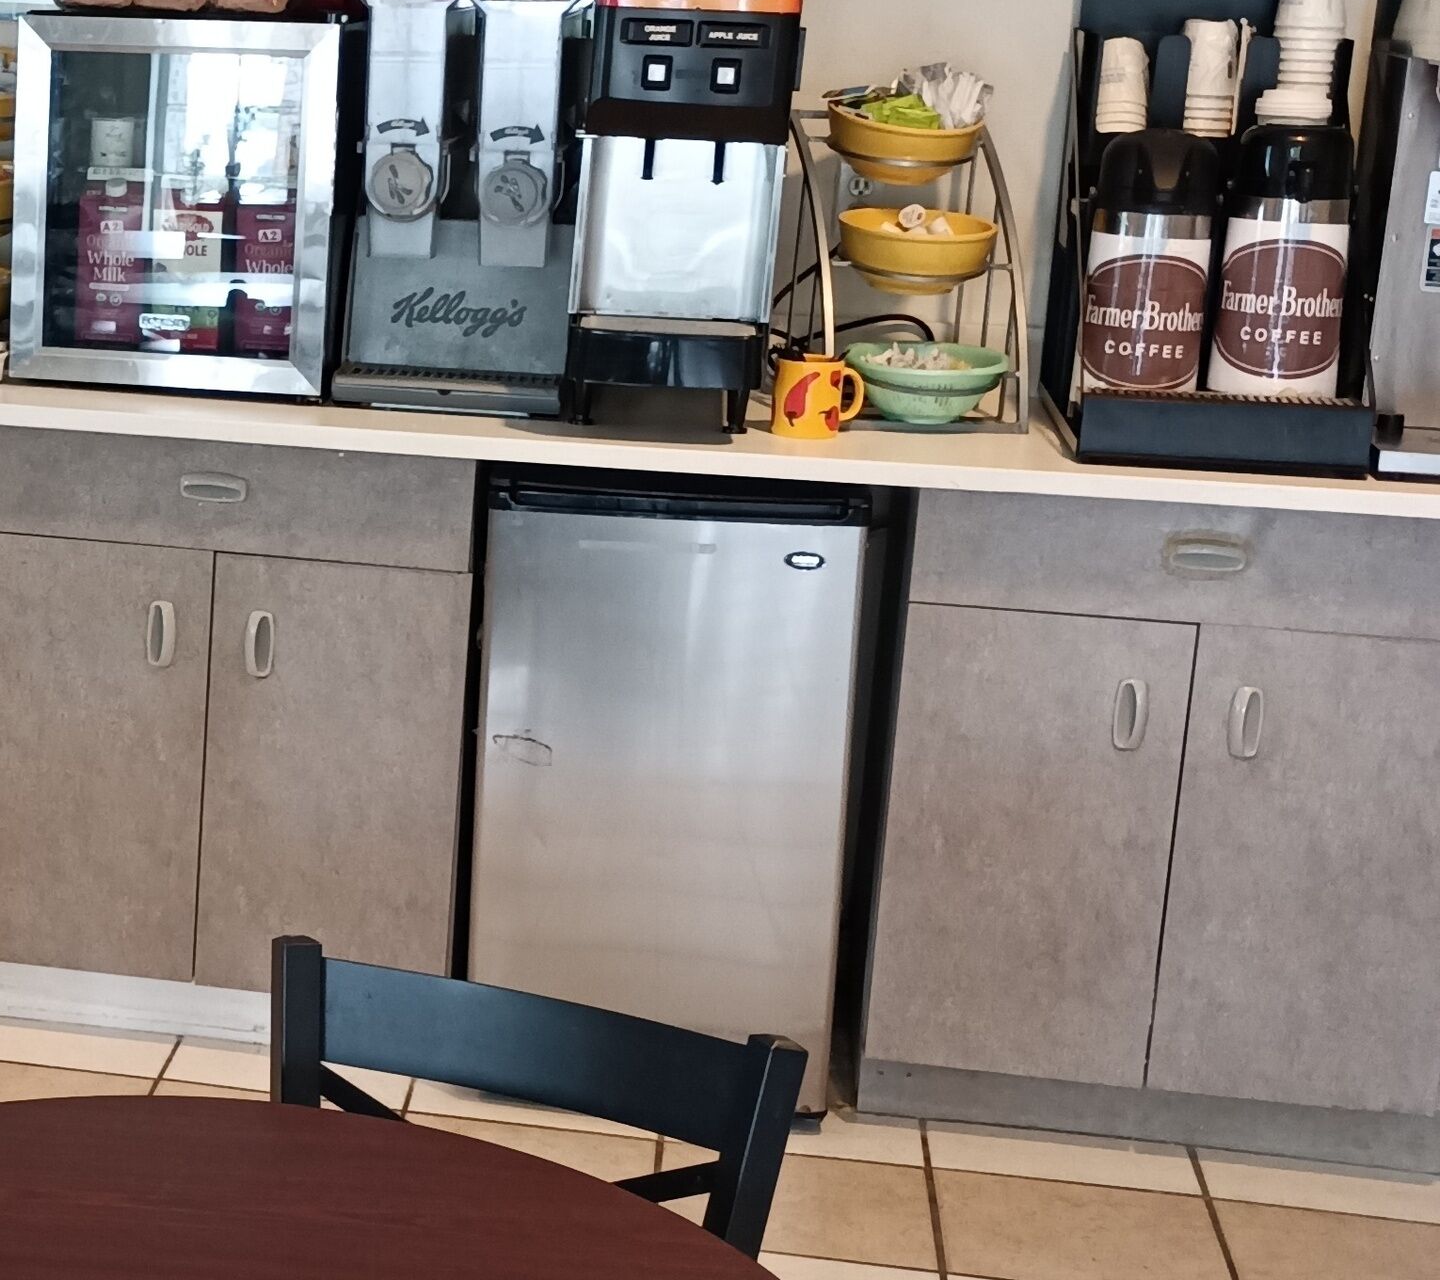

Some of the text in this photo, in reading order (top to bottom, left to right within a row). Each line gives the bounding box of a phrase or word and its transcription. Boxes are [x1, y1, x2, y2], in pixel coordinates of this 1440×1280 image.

[644, 25, 677, 33] ORANGE
[648, 33, 671, 41] JUICE
[708, 31, 759, 41] APPLE JUICE
[103, 222, 121, 232] A2
[261, 231, 278, 241] A2
[87, 249, 135, 267] Whole
[246, 259, 294, 273] Whole
[93, 266, 126, 282] Milk
[1222, 279, 1280, 316] Farmer
[391, 286, 527, 338] Kellogg's
[1085, 294, 1144, 329] Farmer
[1240, 325, 1322, 346] COFFEE
[1104, 339, 1184, 359] COFFEE
